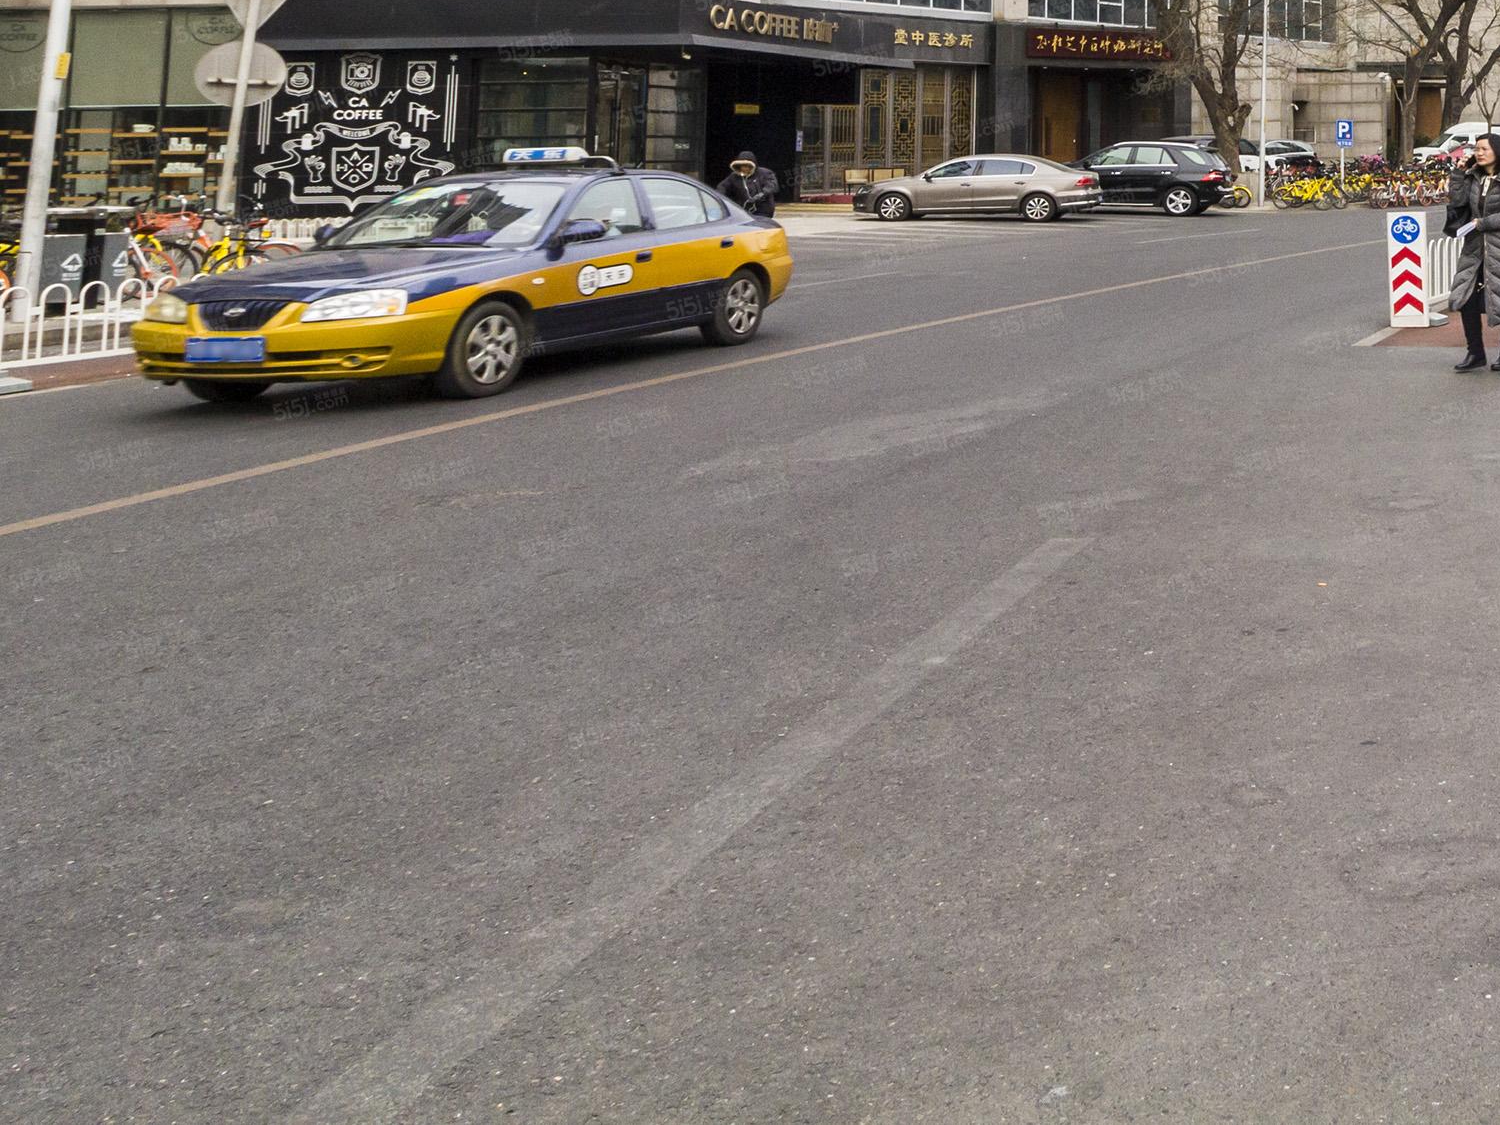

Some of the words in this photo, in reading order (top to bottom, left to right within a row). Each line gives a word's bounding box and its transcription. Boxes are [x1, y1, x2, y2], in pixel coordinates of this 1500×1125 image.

[710, 4, 739, 32] CA
[741, 9, 800, 39] COFFEE
[894, 28, 975, 50] 堂中医诊所
[348, 96, 369, 108] CA
[333, 109, 384, 121] COFFEE
[1338, 121, 1350, 138] P
